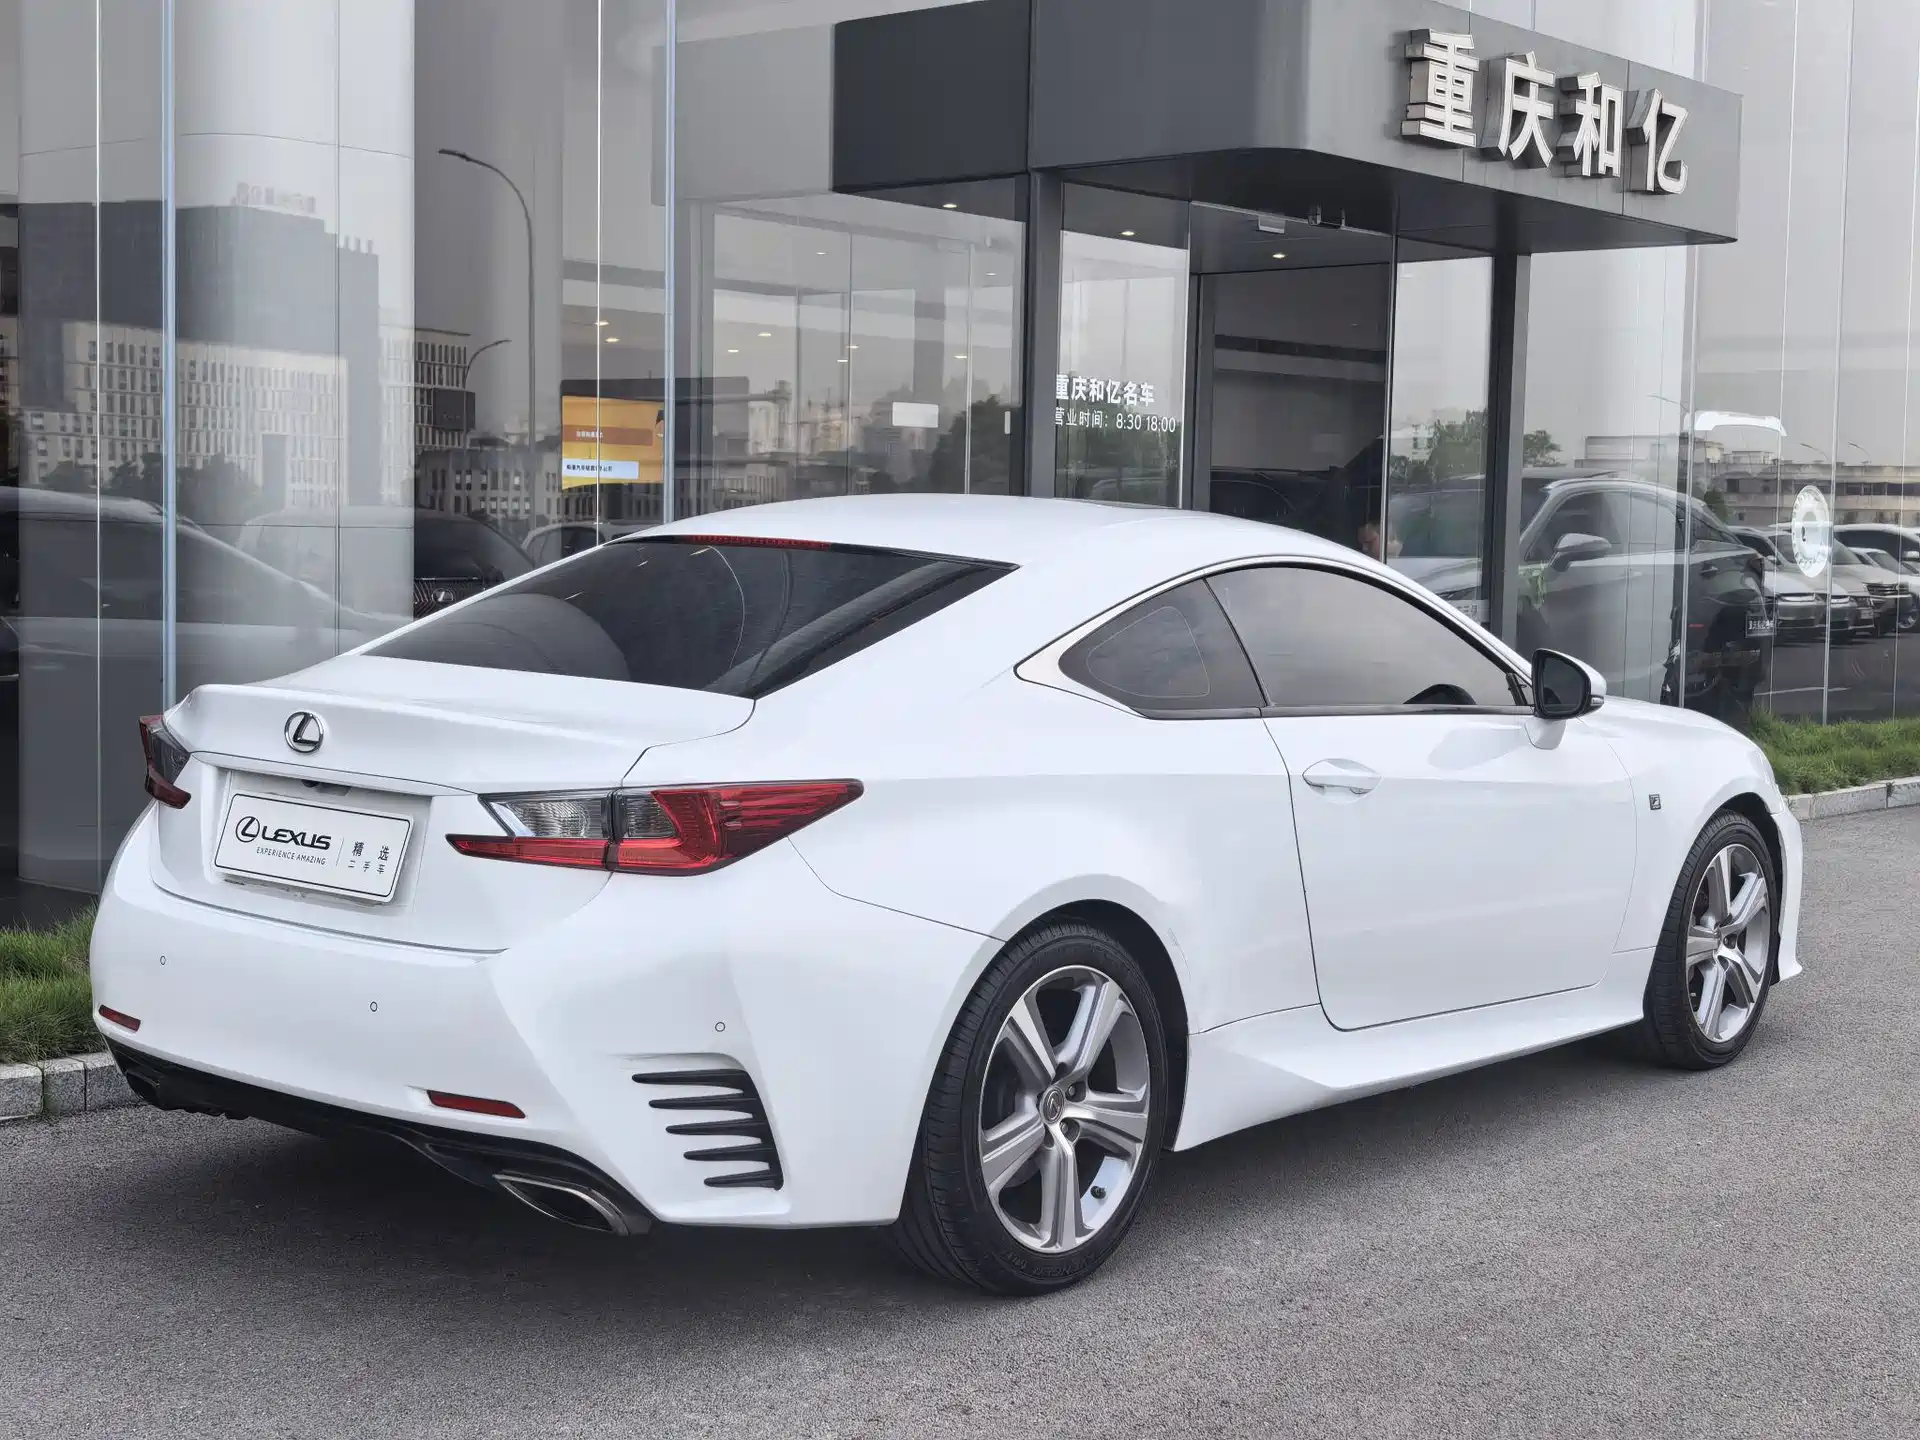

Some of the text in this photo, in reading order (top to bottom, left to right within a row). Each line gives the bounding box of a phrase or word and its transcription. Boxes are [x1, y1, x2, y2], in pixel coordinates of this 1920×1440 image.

[1401, 28, 1688, 194] 重庆和亿
[1056, 374, 1155, 406] 重庆和亿名车
[1115, 413, 1142, 430] 8:30
[1146, 416, 1176, 432] 18:00
[261, 826, 332, 851] LEXUS
[256, 846, 327, 866] EXPERIENCE AMAZING
